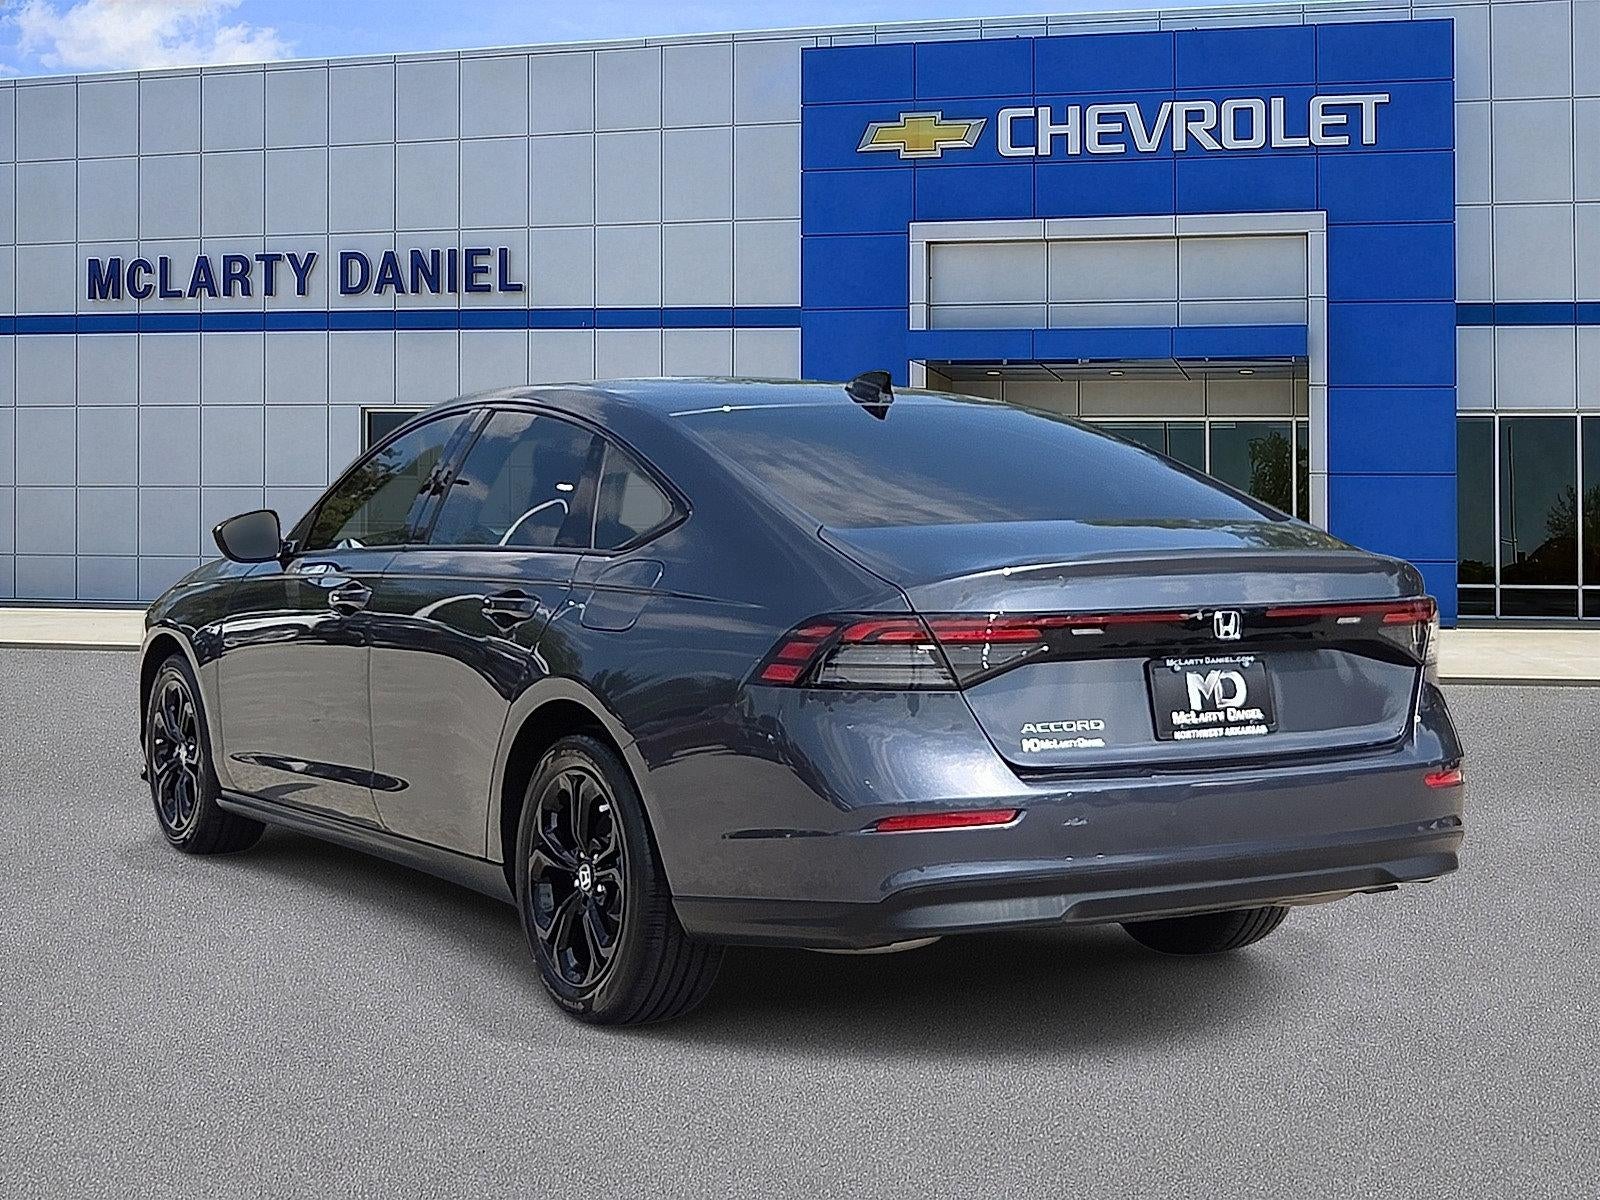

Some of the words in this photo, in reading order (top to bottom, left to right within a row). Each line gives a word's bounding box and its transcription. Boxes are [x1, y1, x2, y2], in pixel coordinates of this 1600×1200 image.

[996, 93, 1390, 158] CHEVROLET
[339, 246, 525, 296] DANIEL
[1020, 718, 1105, 734] ACCORD
